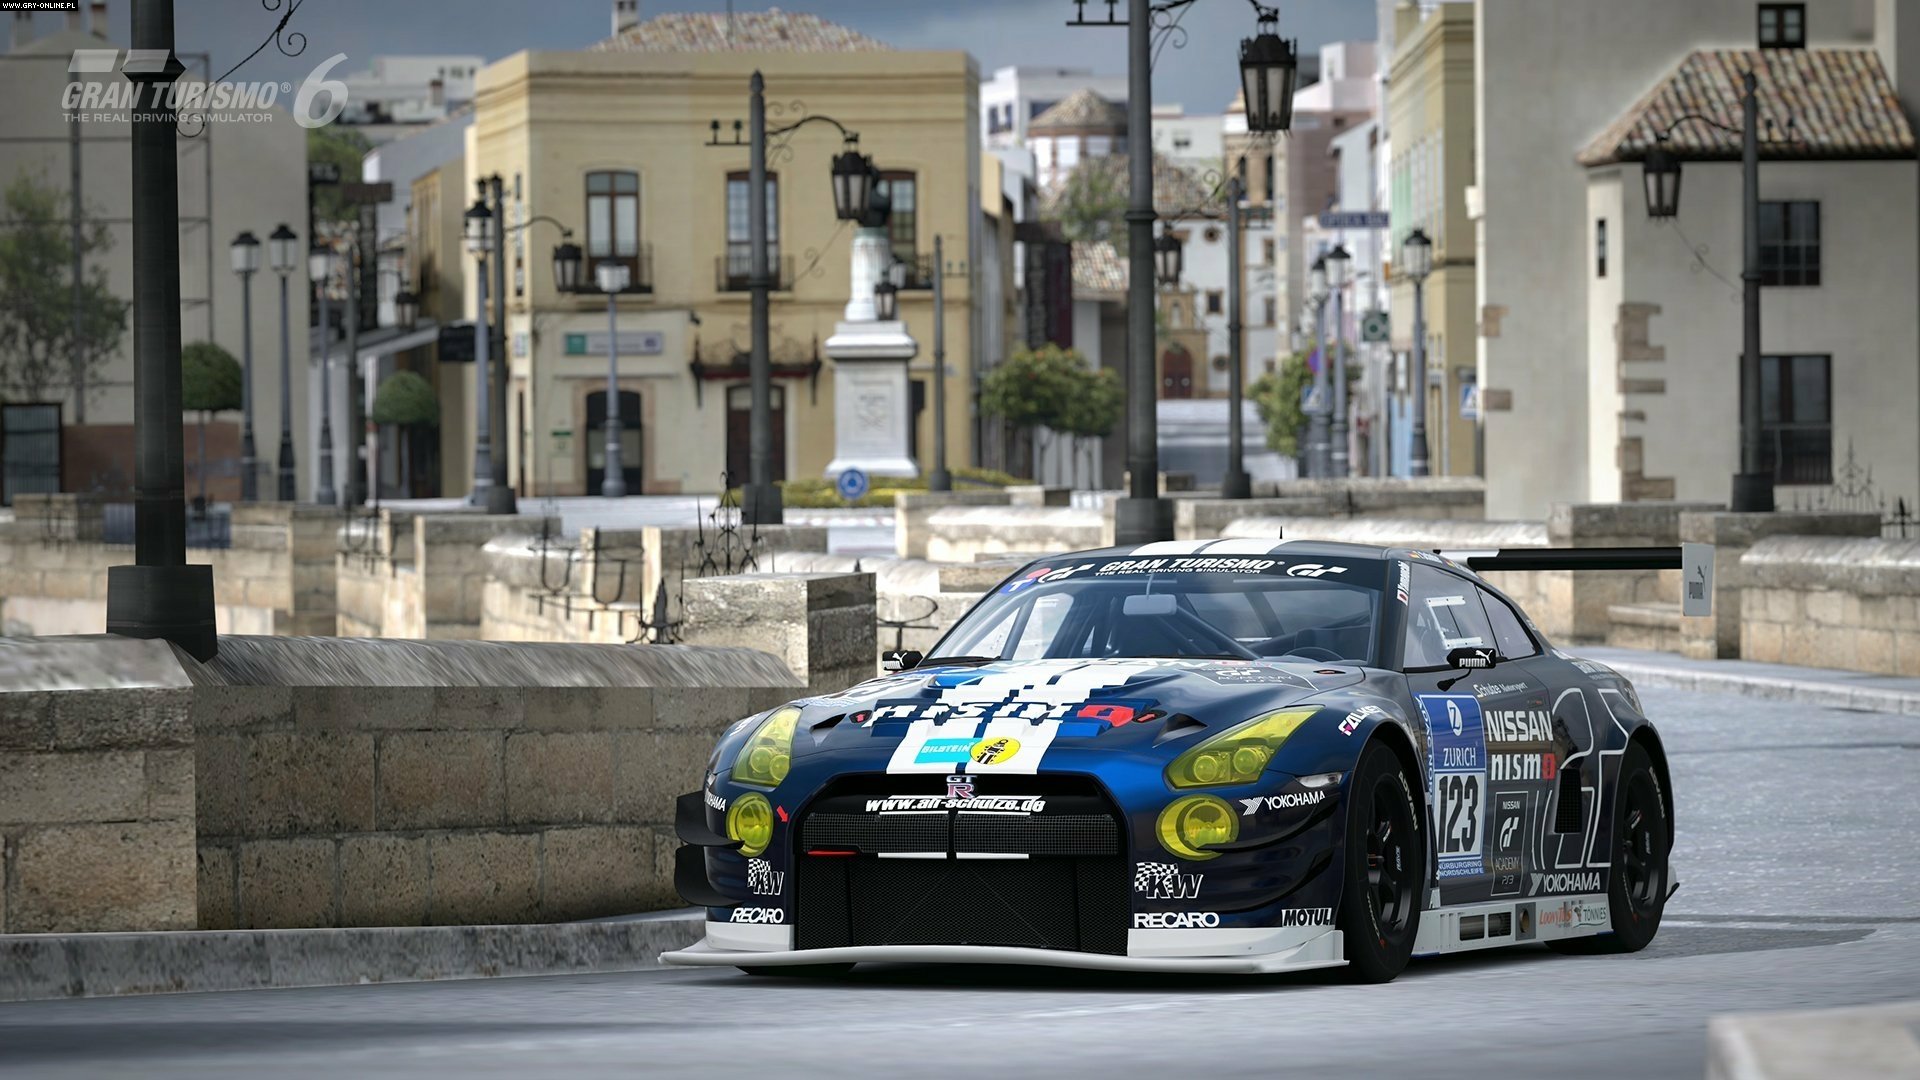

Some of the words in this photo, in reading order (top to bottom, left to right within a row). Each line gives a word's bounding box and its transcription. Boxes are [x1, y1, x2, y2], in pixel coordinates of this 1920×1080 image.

[1099, 558, 1169, 573] GRAN
[1485, 710, 1554, 742] NISSAN
[920, 743, 972, 754] BILSTEIN
[1443, 747, 1477, 767] ZURICH
[1438, 775, 1479, 853] 123
[1502, 801, 1521, 809] NISSAN
[753, 871, 785, 895] KW
[1146, 873, 1204, 899] KW
[1544, 872, 1601, 893] YOKOHAMA
[729, 907, 785, 924] RECARO
[1133, 912, 1220, 928] RECARO
[1283, 908, 1331, 927] MOTUL
